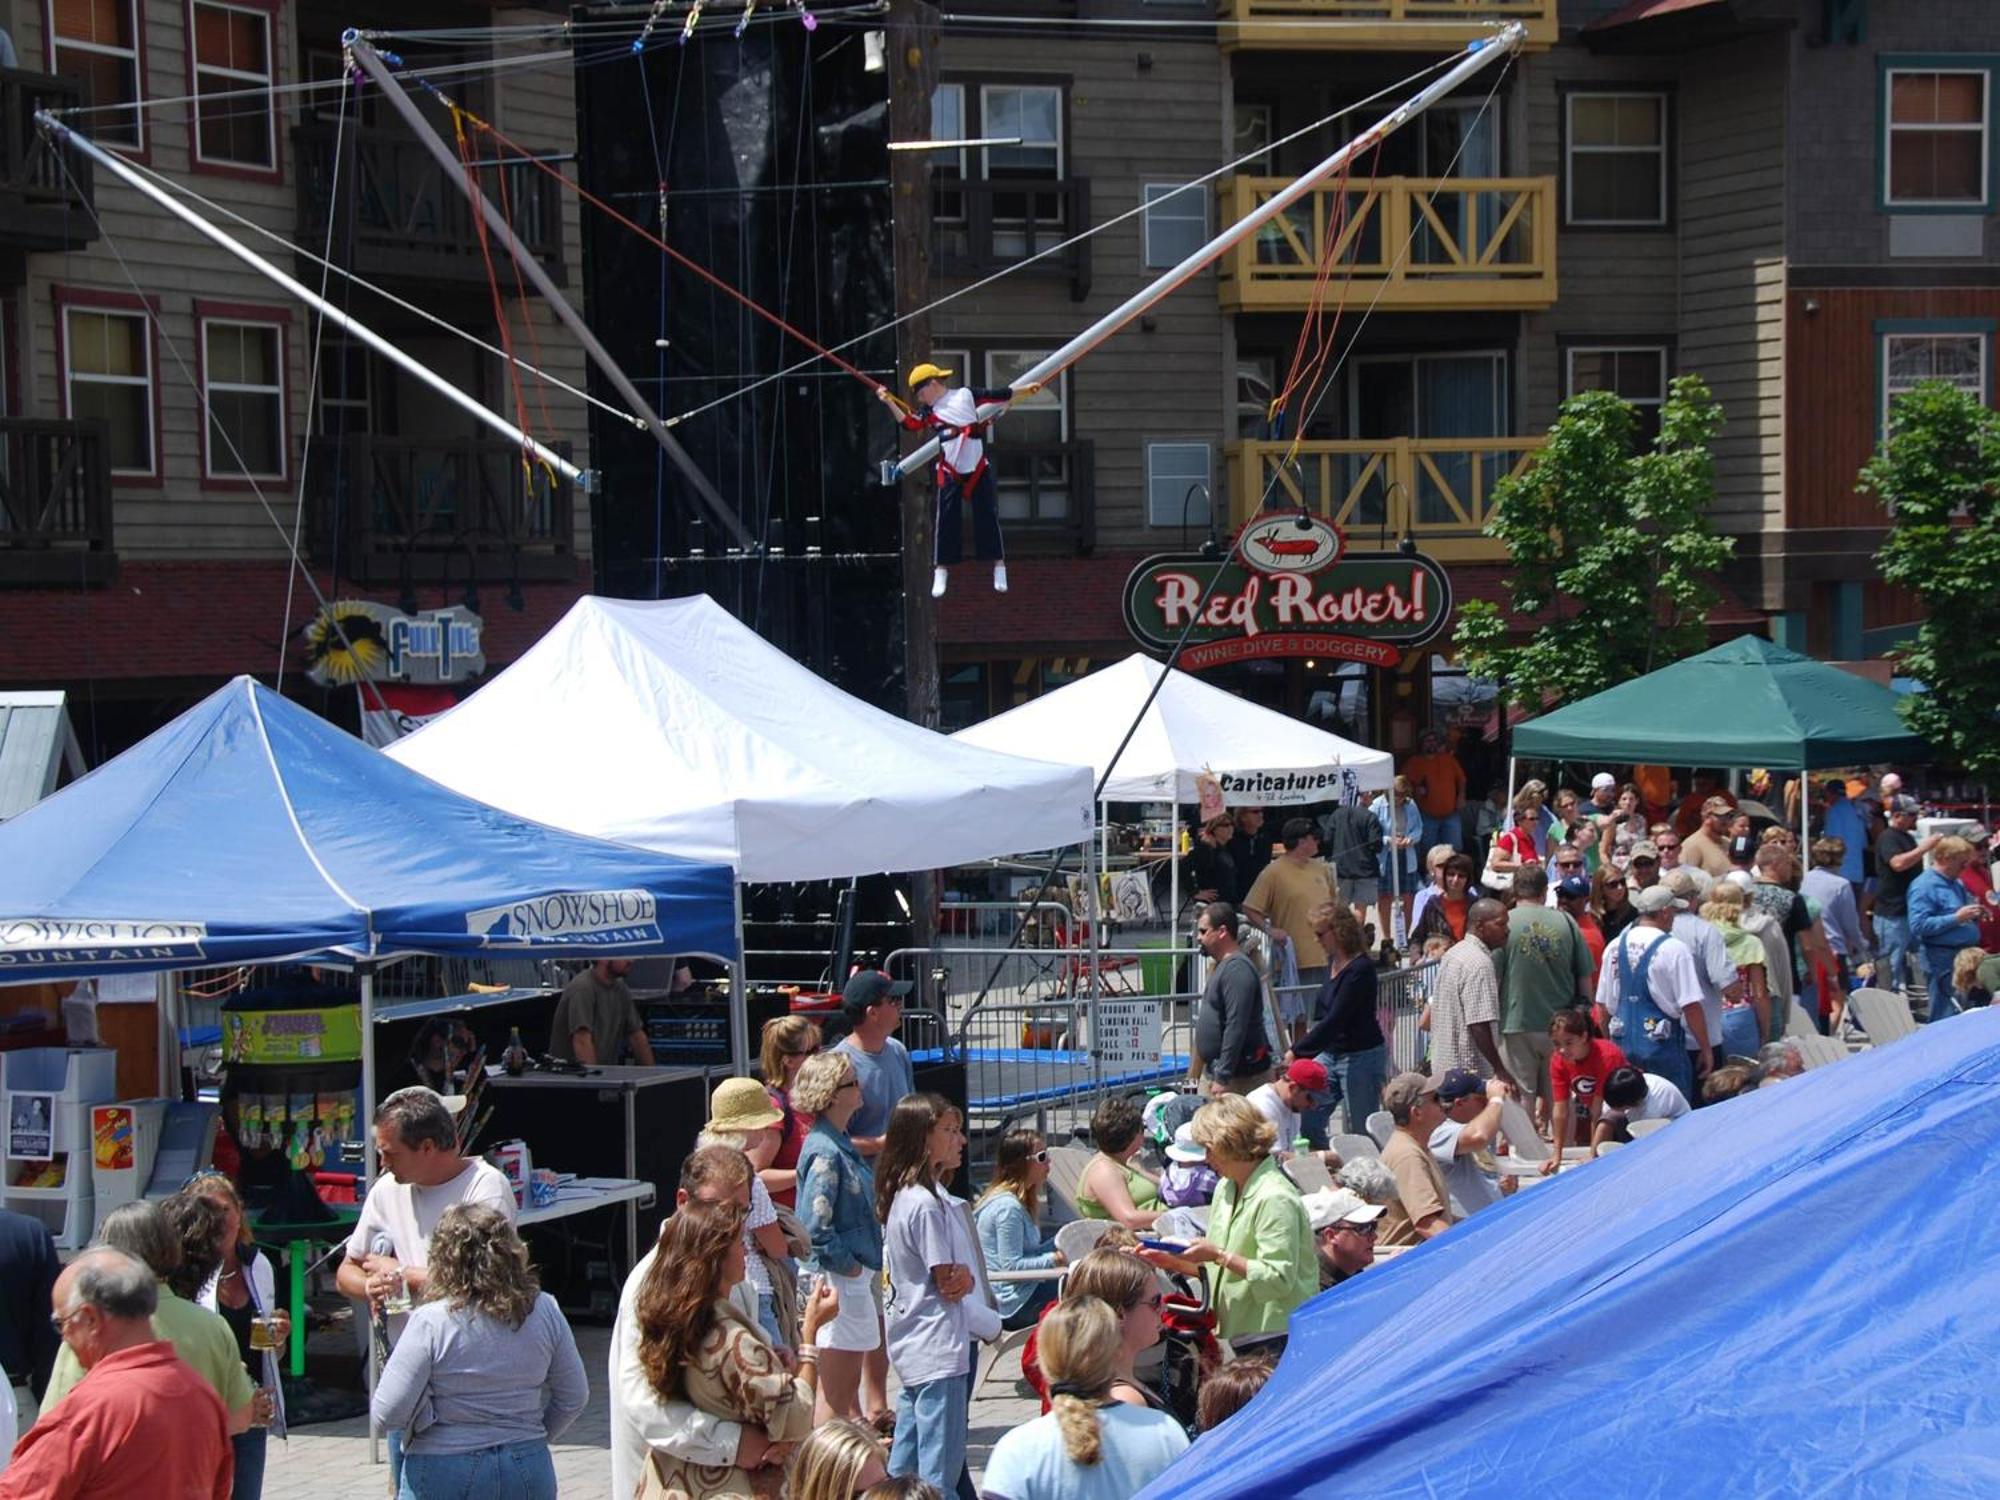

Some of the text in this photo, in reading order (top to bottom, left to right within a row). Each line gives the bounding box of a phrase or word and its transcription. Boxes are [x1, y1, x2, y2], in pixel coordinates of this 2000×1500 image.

[1155, 571, 1425, 637] Red Rover!
[1191, 639, 1388, 664] WINE DIVE & DOGGERY
[1220, 772, 1338, 792] Caricatures
[513, 892, 654, 936] SNOWSHOE
[0, 947, 174, 964] OUNTAIN
[1099, 1017, 1129, 1026] LIMBING
